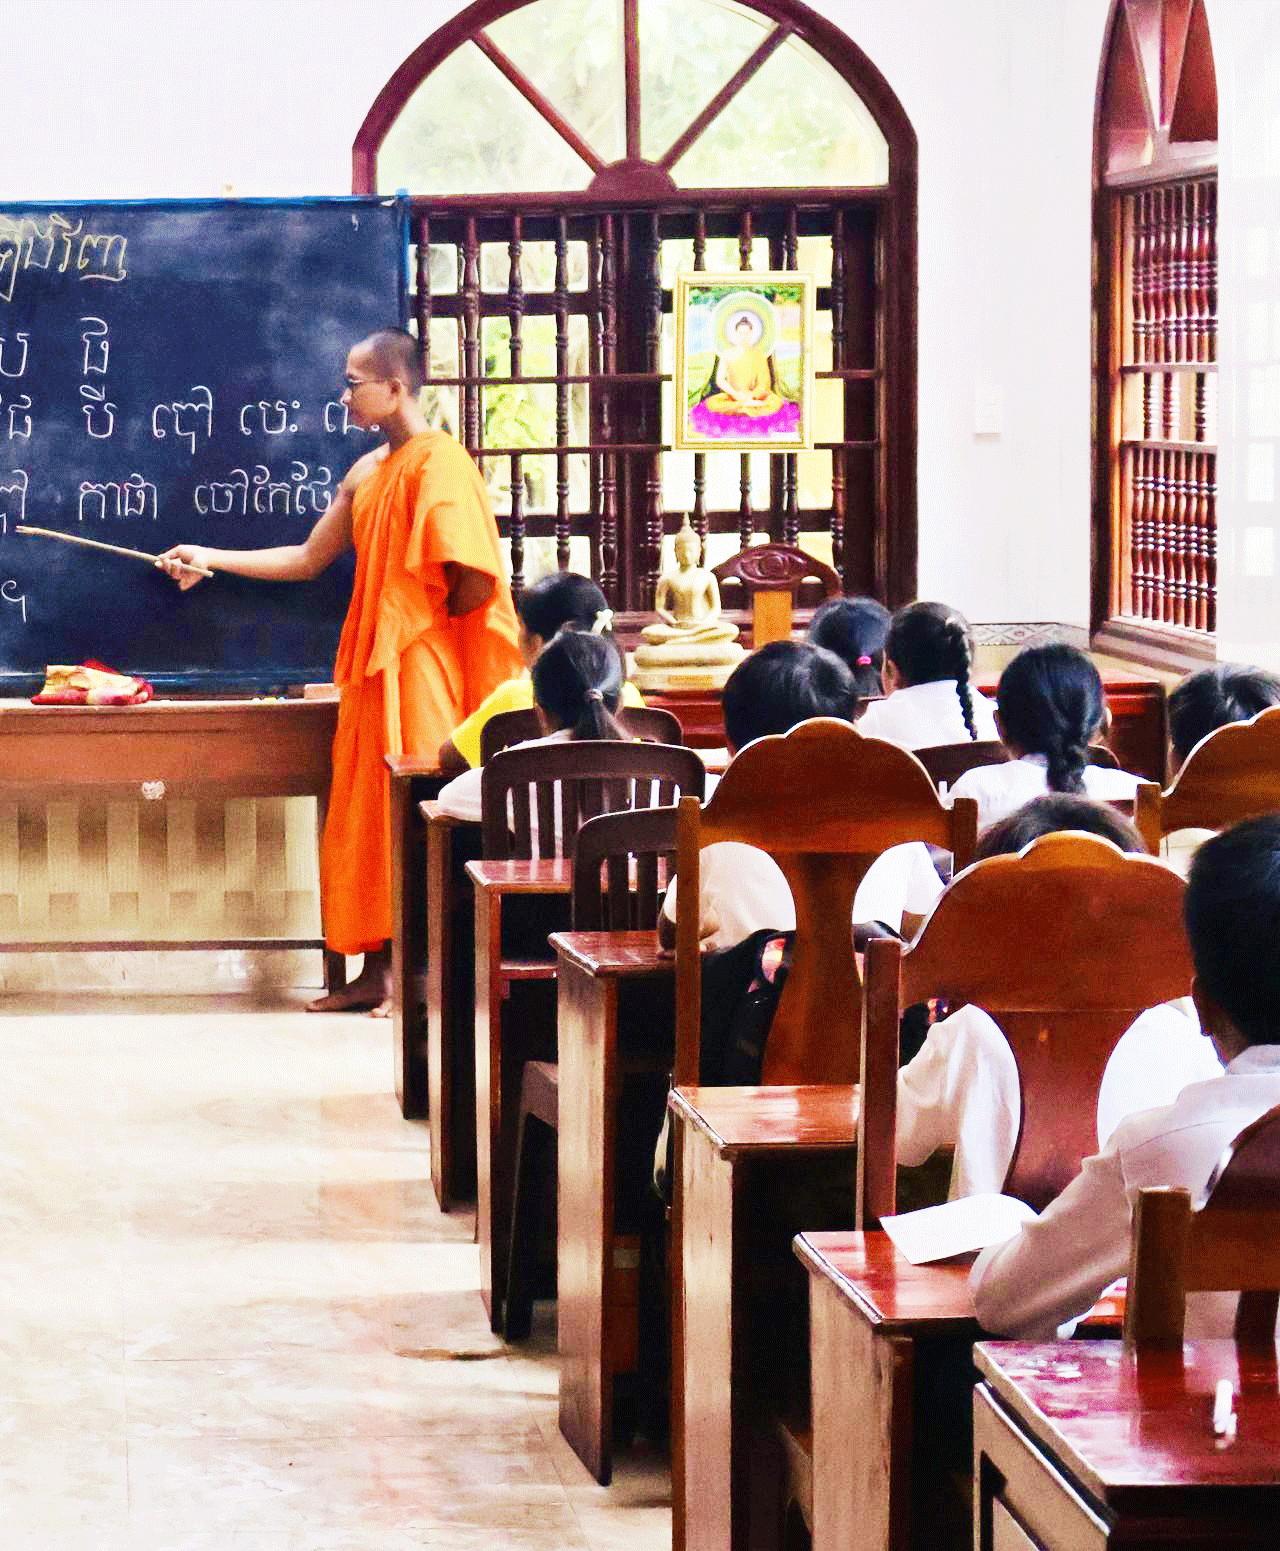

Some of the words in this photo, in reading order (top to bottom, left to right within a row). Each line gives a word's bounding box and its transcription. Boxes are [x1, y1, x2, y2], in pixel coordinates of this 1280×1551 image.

[80, 316, 109, 375] ផ
[80, 384, 118, 439] បី
[240, 400, 301, 436] បេះ
